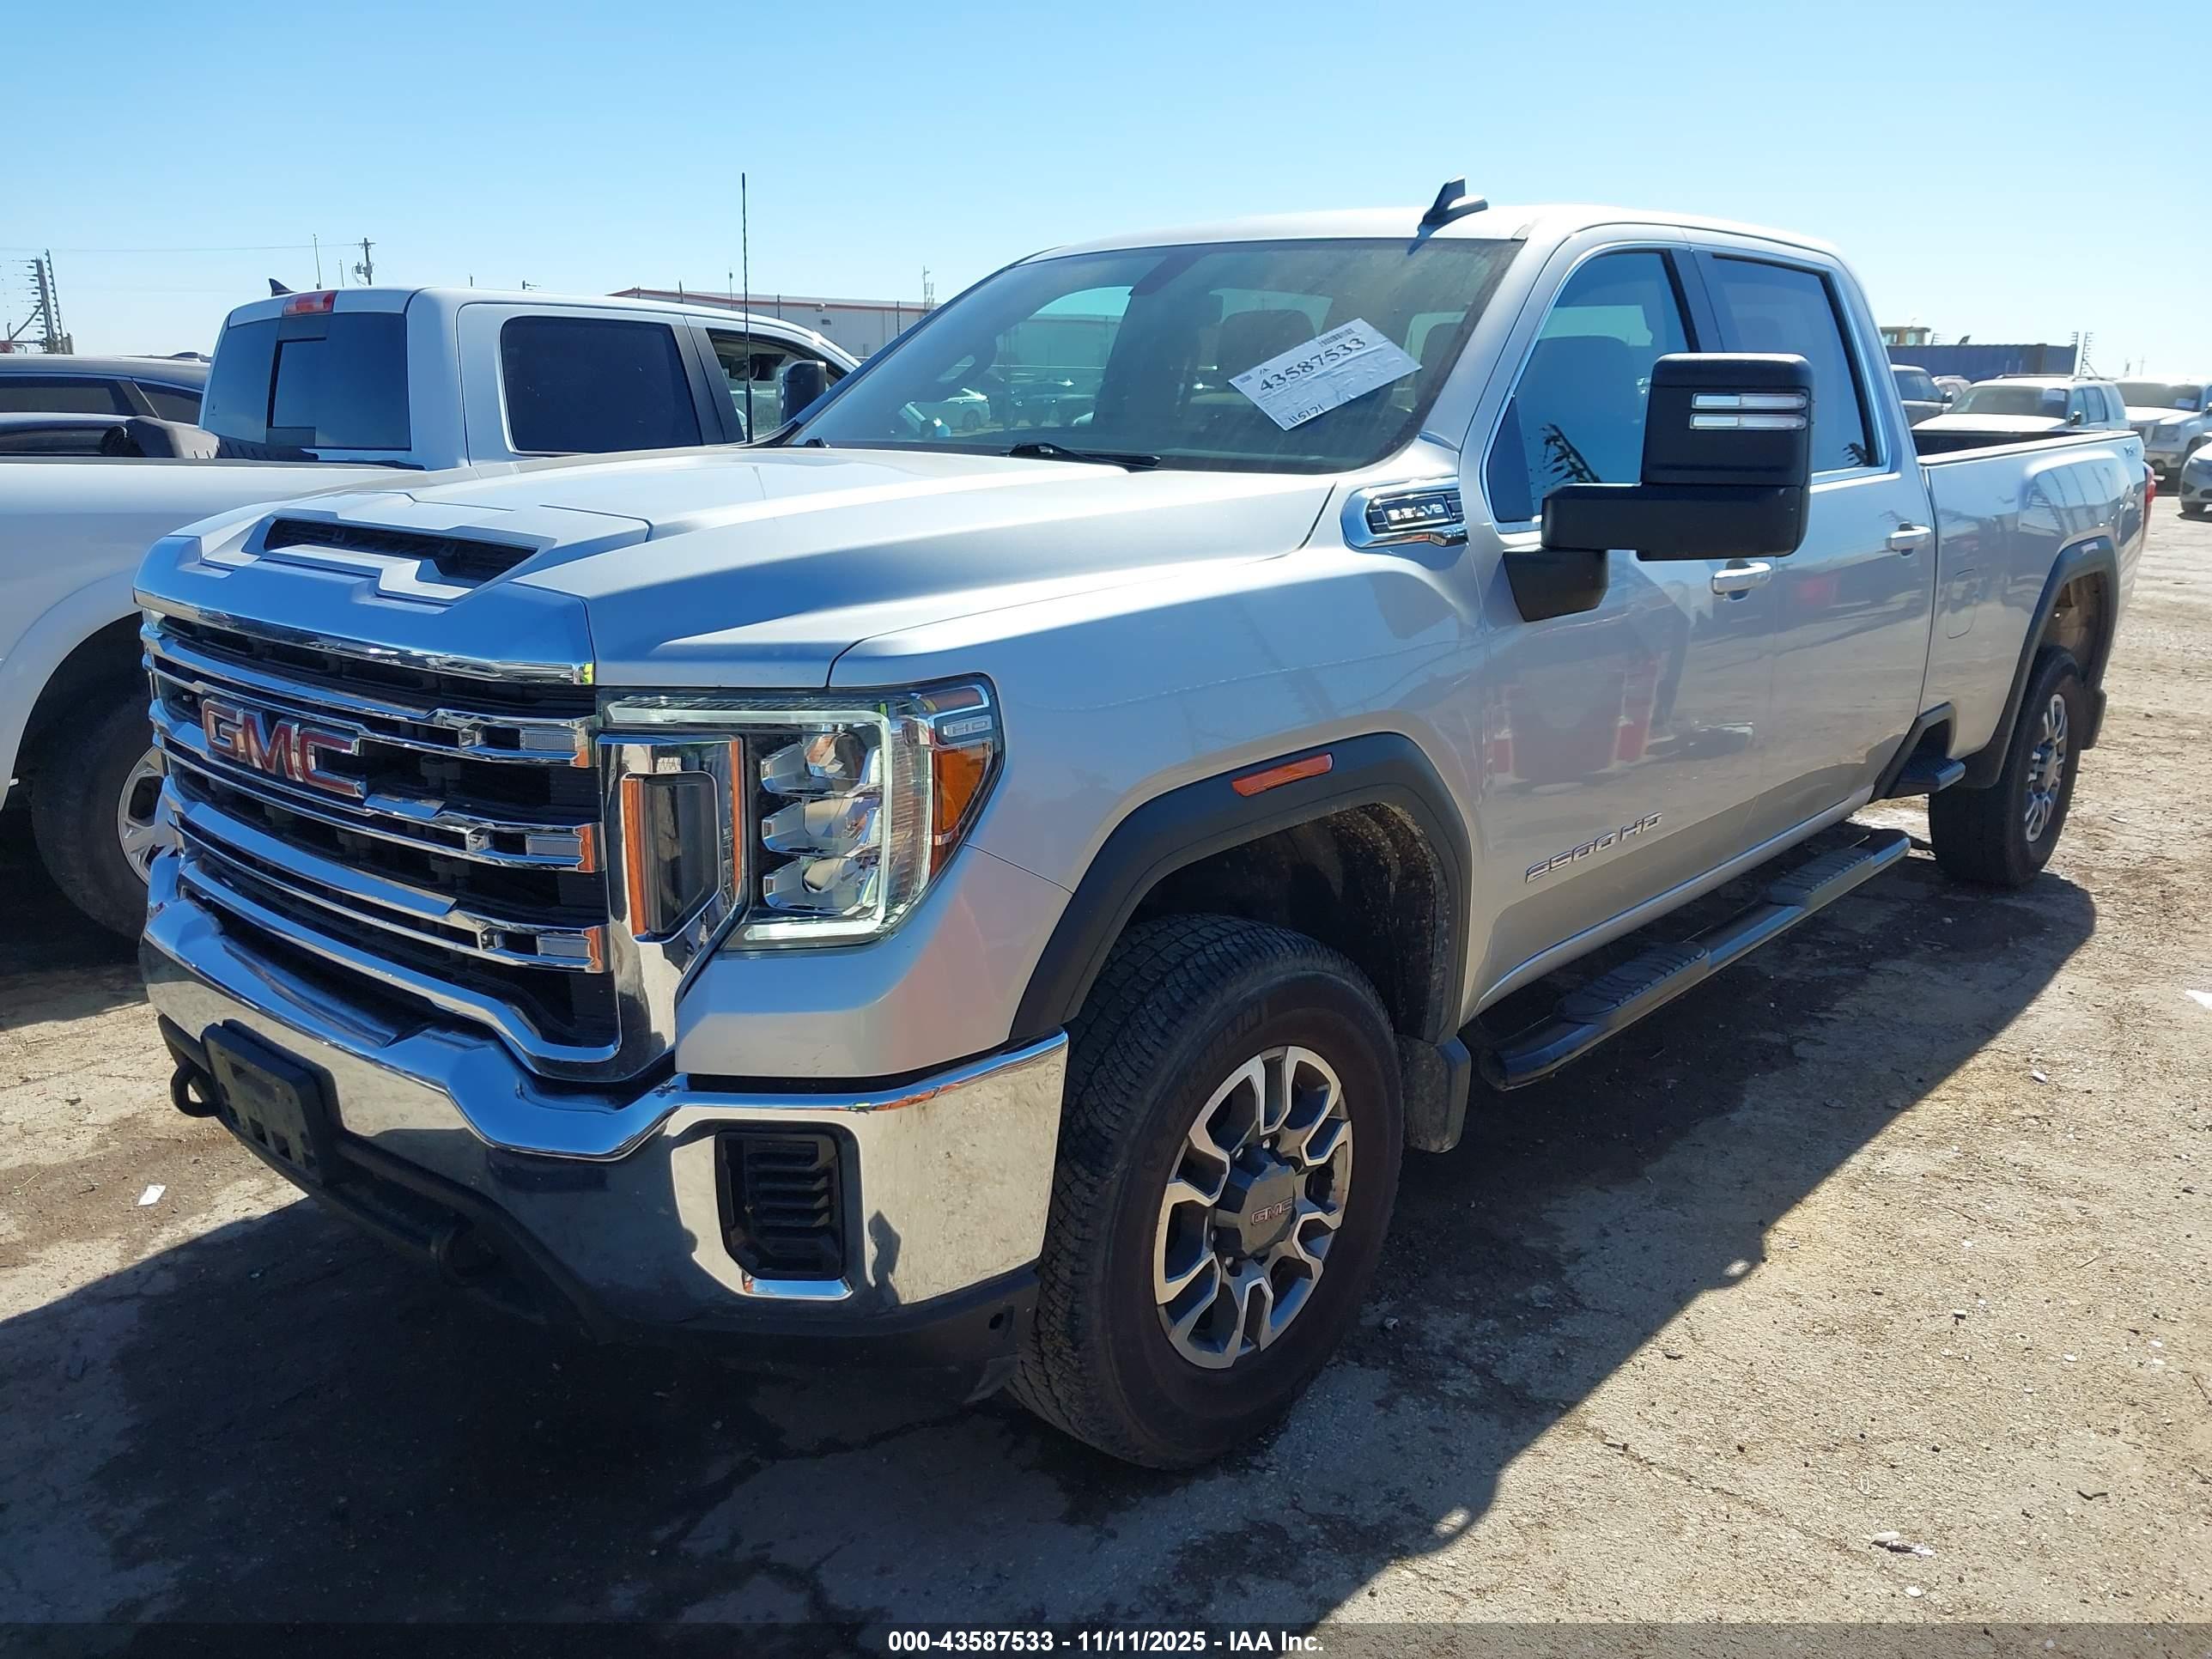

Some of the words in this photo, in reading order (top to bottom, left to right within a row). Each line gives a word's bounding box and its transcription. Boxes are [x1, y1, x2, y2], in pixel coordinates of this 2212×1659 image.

[1259, 337, 1366, 392] 43587533
[1420, 503, 1445, 515] V8
[202, 698, 368, 799] GMC
[1525, 831, 1616, 884] 2500
[1620, 811, 1663, 842] HD
[1250, 1197, 1292, 1225] GMC
